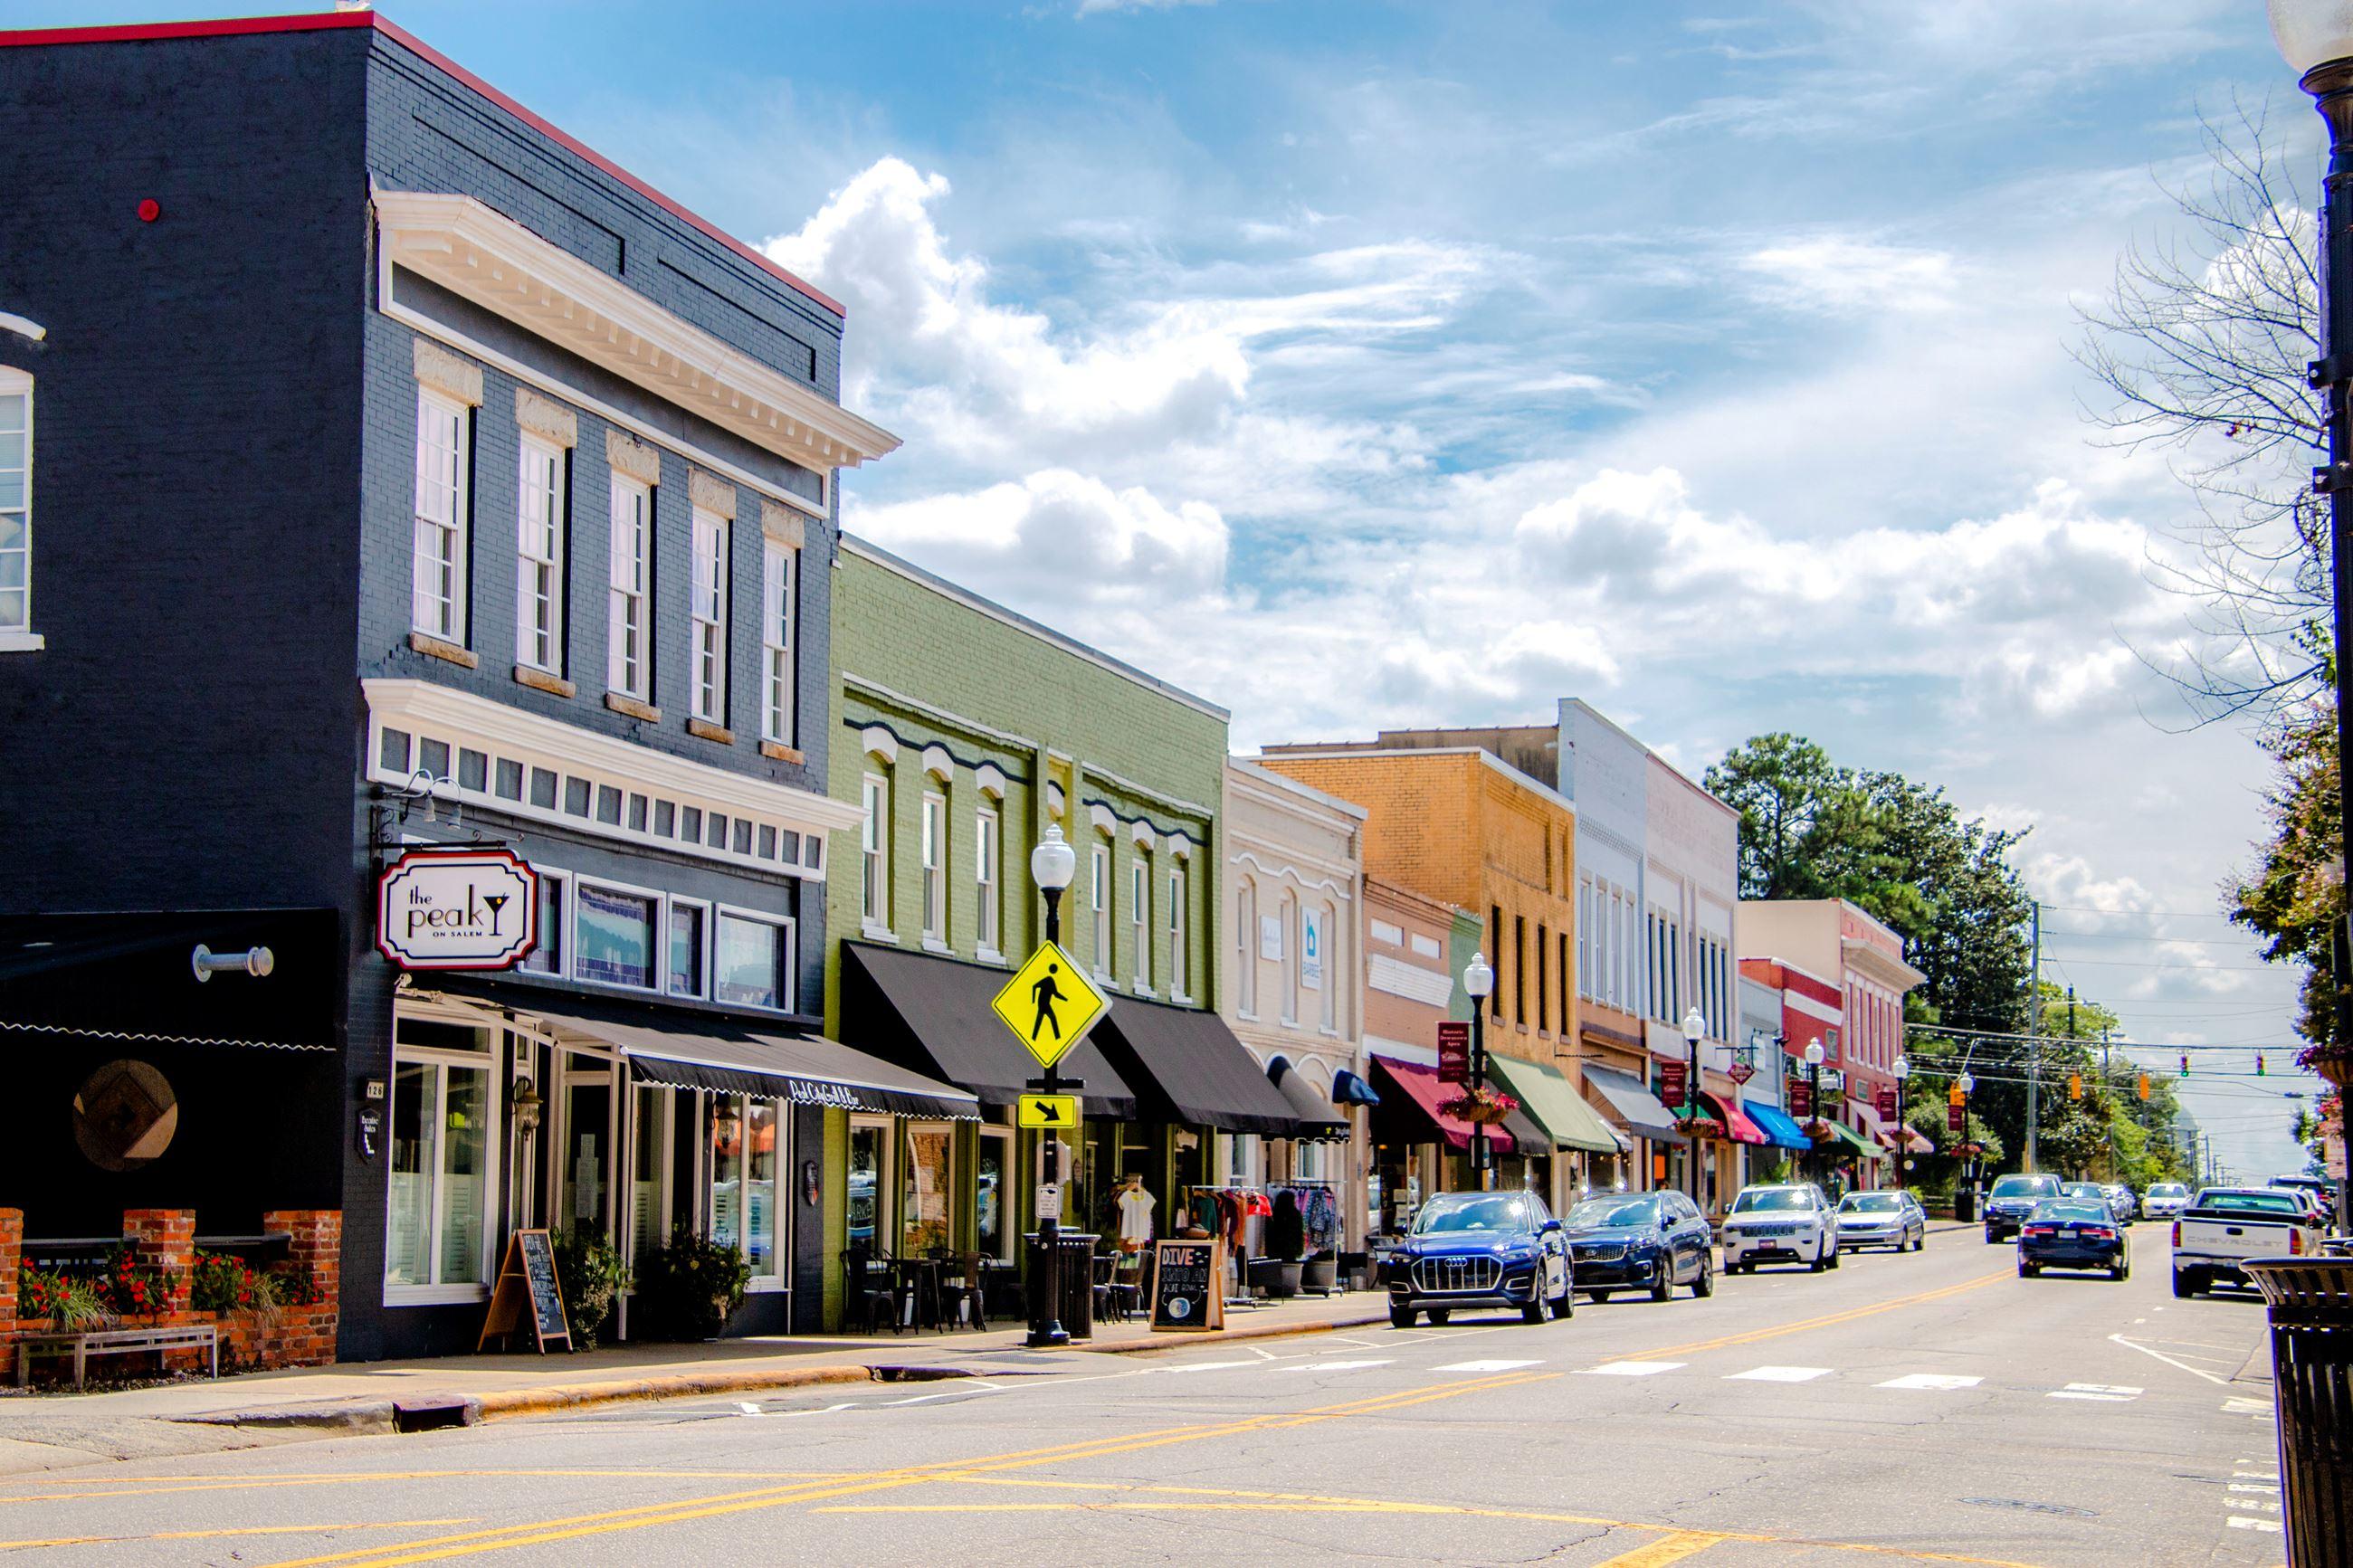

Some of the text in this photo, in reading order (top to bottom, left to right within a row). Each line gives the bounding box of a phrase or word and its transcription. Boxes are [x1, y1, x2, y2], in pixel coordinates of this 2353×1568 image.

[409, 885, 433, 905] the
[407, 883, 484, 939] peak
[367, 1086, 383, 1096] 126
[2186, 1236, 2283, 1248] CHEVROLET
[1161, 1248, 1196, 1266] DIVE
